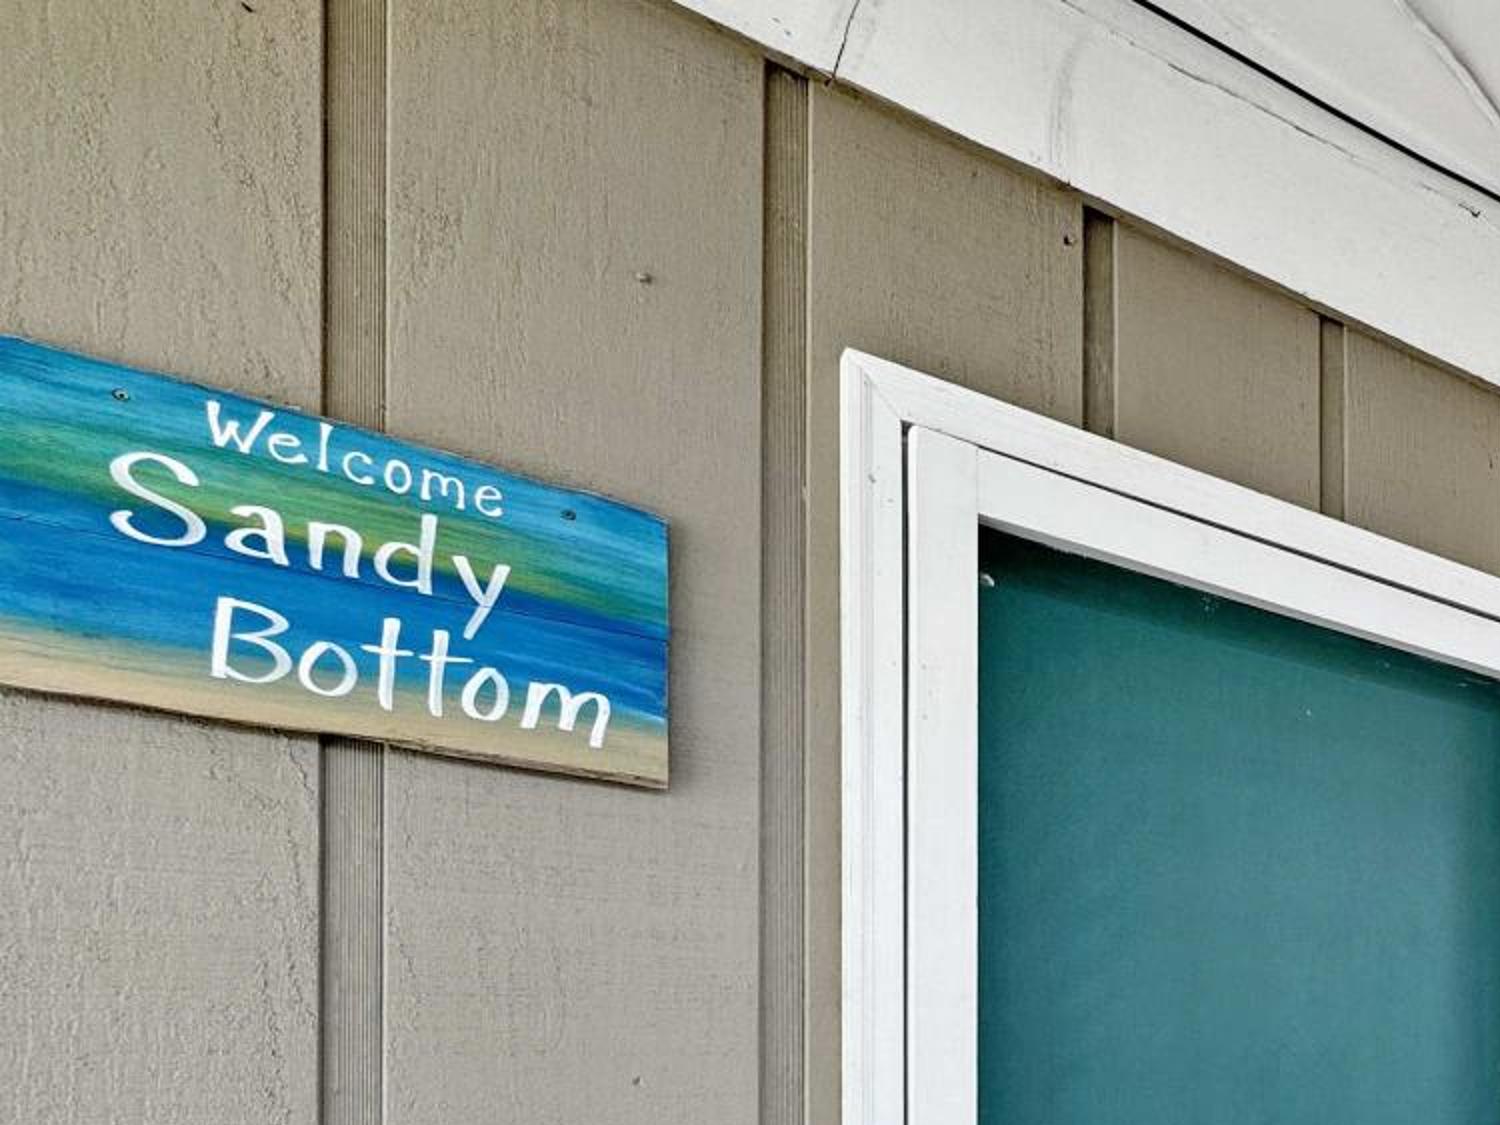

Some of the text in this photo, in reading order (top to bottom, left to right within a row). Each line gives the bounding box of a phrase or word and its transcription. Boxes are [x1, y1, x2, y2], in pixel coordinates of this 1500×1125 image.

[205, 400, 503, 517] Welcome
[109, 451, 511, 639] Sandy
[210, 596, 611, 749] Bottom
